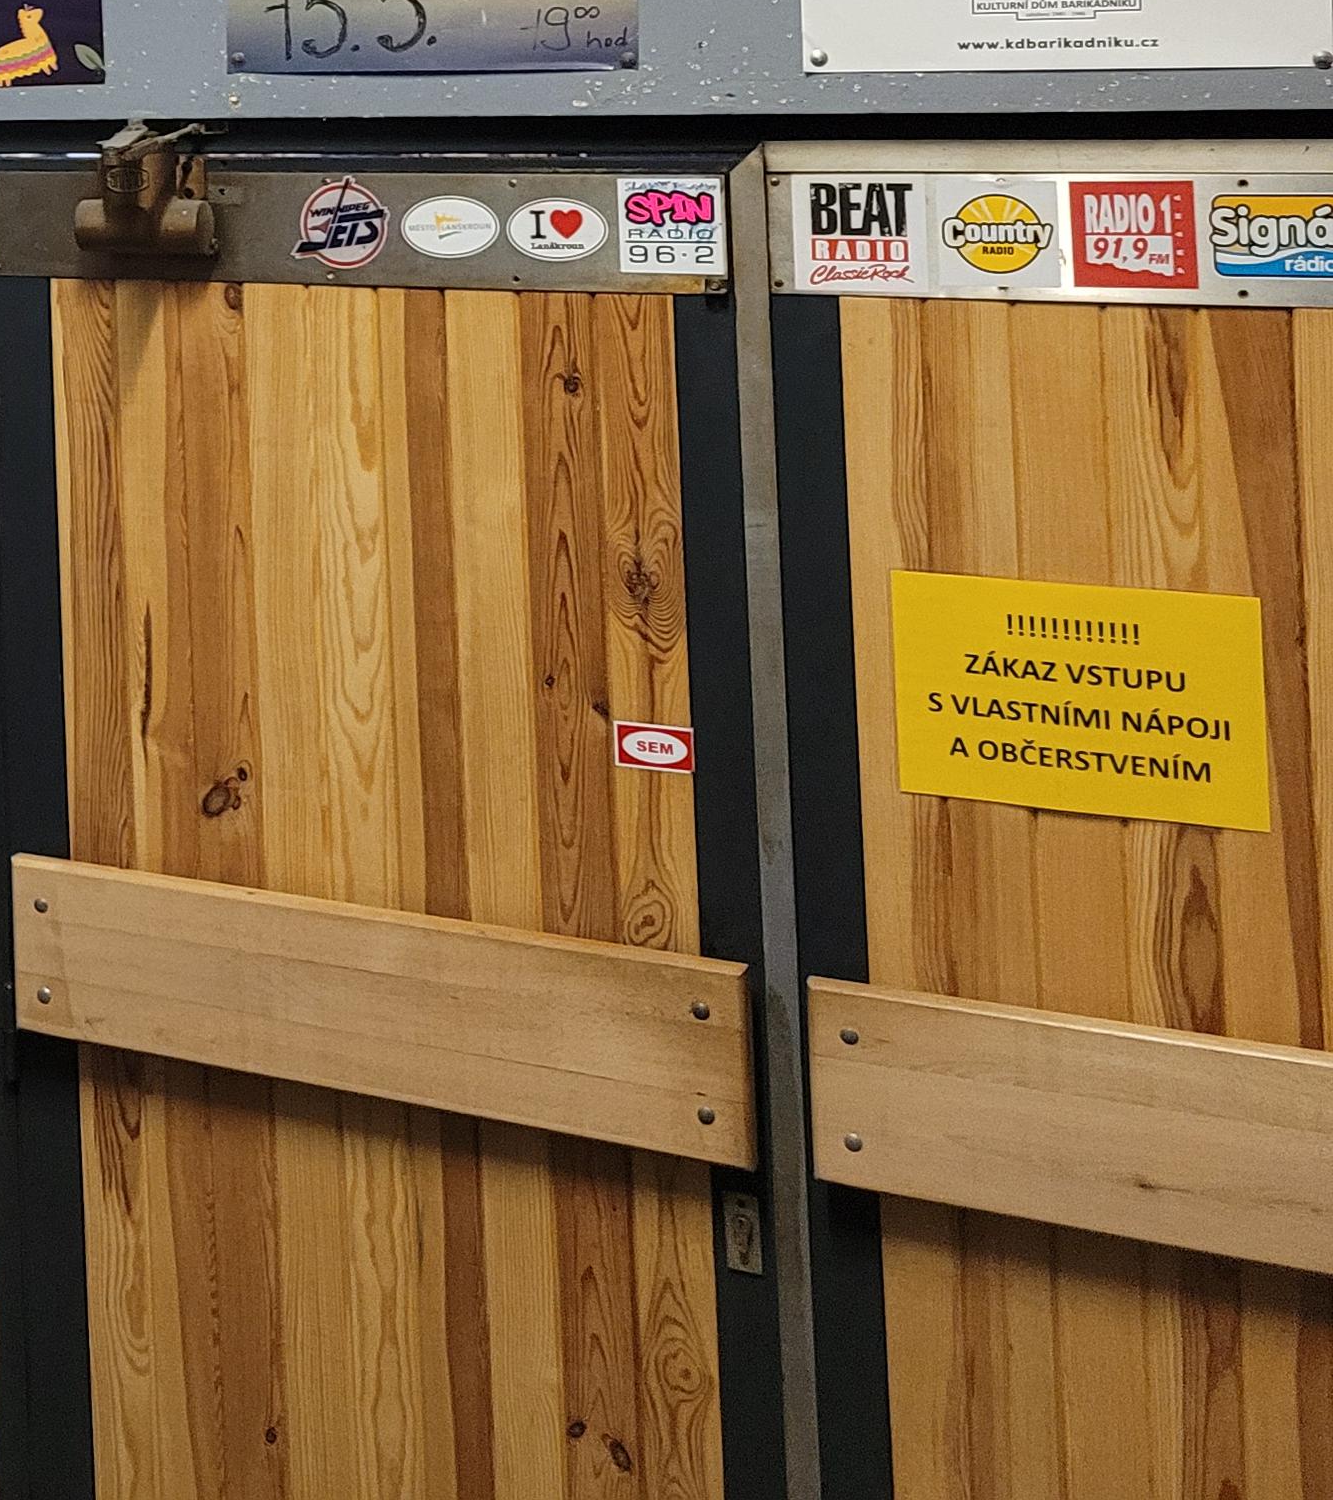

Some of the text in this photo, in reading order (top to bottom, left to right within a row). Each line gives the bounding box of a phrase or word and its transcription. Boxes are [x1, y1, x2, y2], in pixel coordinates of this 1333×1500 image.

[977, 0, 1028, 10] KULTURNÍ
[1031, 0, 1058, 9] DŮM
[957, 37, 1159, 50] www.kdbarikadniku.cz
[310, 202, 373, 217] WINNIPEG
[625, 189, 715, 227] SPIN
[810, 183, 913, 236] BEAT
[1083, 193, 1171, 234] RADIO 1
[530, 210, 546, 239] I
[628, 228, 714, 240] RADIO
[942, 217, 1053, 249] Country
[815, 241, 906, 260] RADIO
[982, 246, 1014, 255] RADIO
[1093, 237, 1170, 265] 91,9 FM
[964, 650, 1186, 693] ZÁKAZ VSTUPU
[928, 692, 1231, 741] S VLASTNÍMI NÁPOJI
[636, 740, 674, 755] SEM
[949, 736, 1212, 783] A OBČERSTVENÍM
